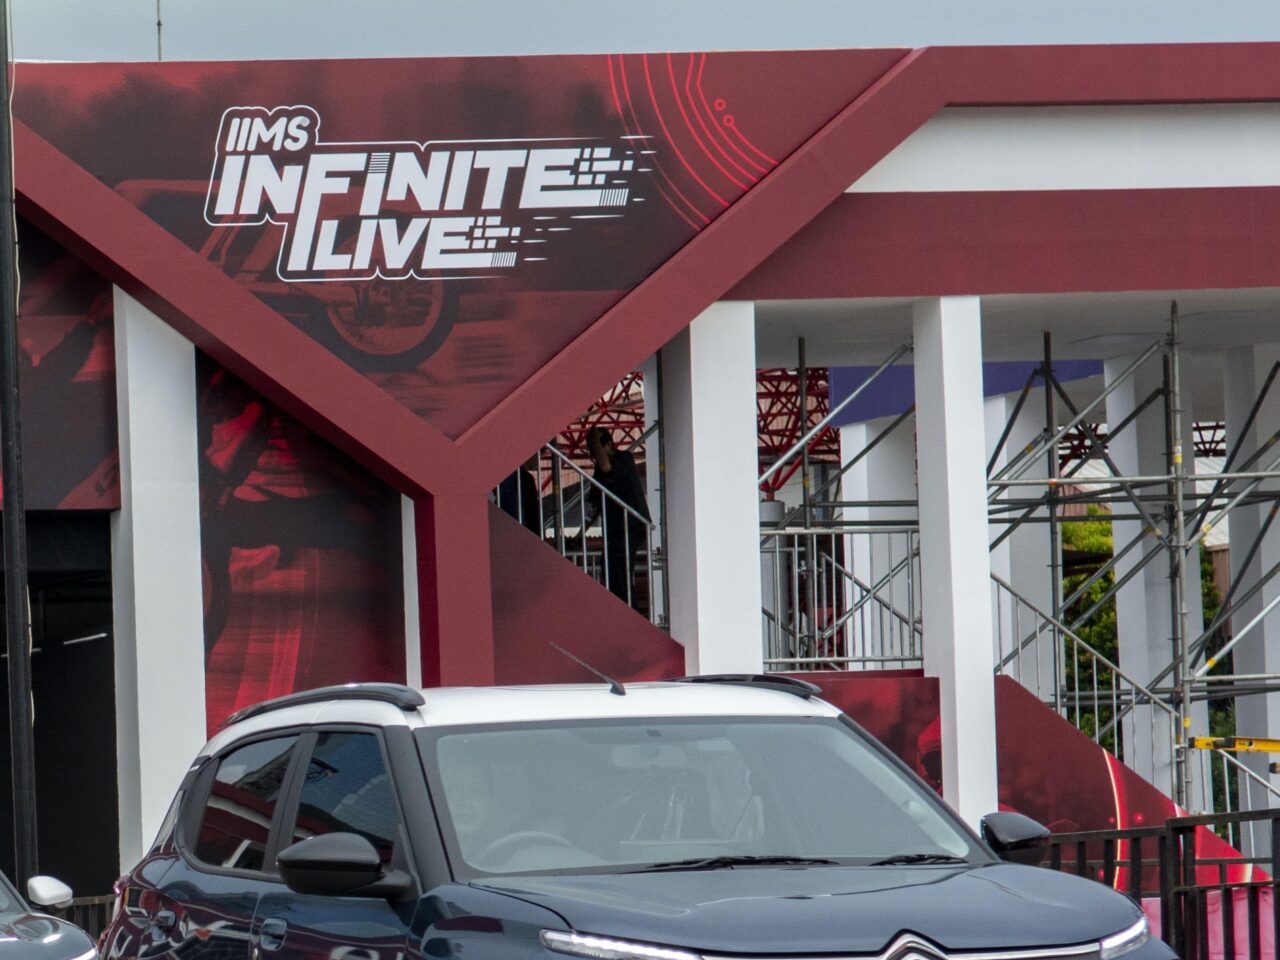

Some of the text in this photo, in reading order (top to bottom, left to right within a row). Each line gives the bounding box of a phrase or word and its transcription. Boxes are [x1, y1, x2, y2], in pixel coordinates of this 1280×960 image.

[226, 116, 311, 152] IIMS
[214, 147, 632, 271] INFINITE
[312, 216, 521, 271] LIVE
